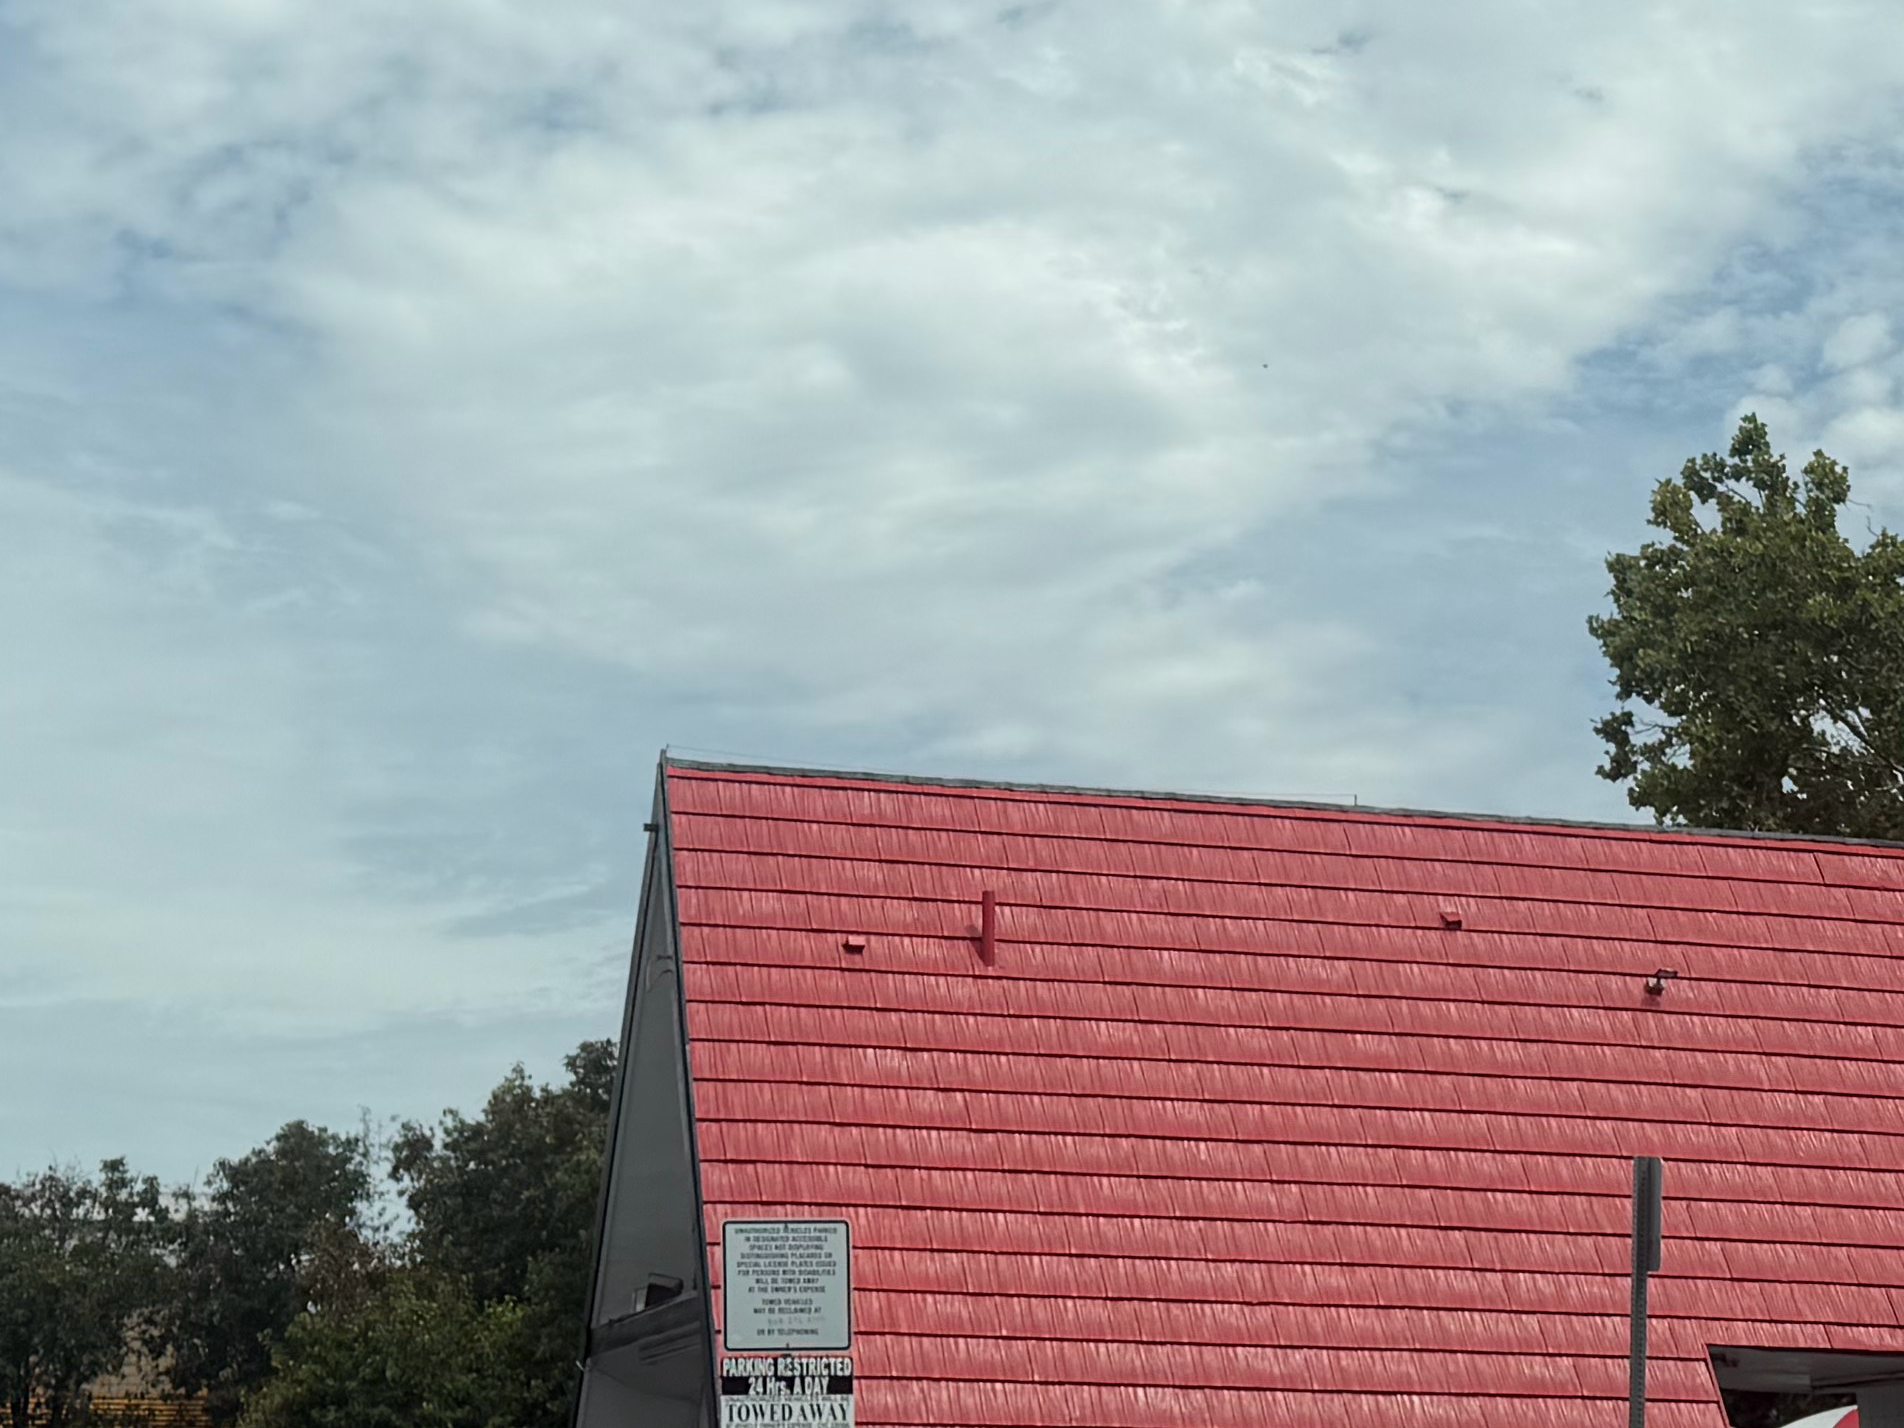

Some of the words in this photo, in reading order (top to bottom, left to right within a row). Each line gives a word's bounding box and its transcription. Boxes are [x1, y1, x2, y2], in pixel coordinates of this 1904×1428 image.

[723, 1357, 775, 1377] PARKING
[777, 1357, 852, 1376] RESTRICTED
[748, 1377, 764, 1395] 24
[766, 1377, 790, 1395] Hrs.
[793, 1377, 802, 1395] A
[804, 1377, 829, 1395] DAY
[726, 1403, 793, 1422] TOWED
[799, 1403, 848, 1421] AWAY
